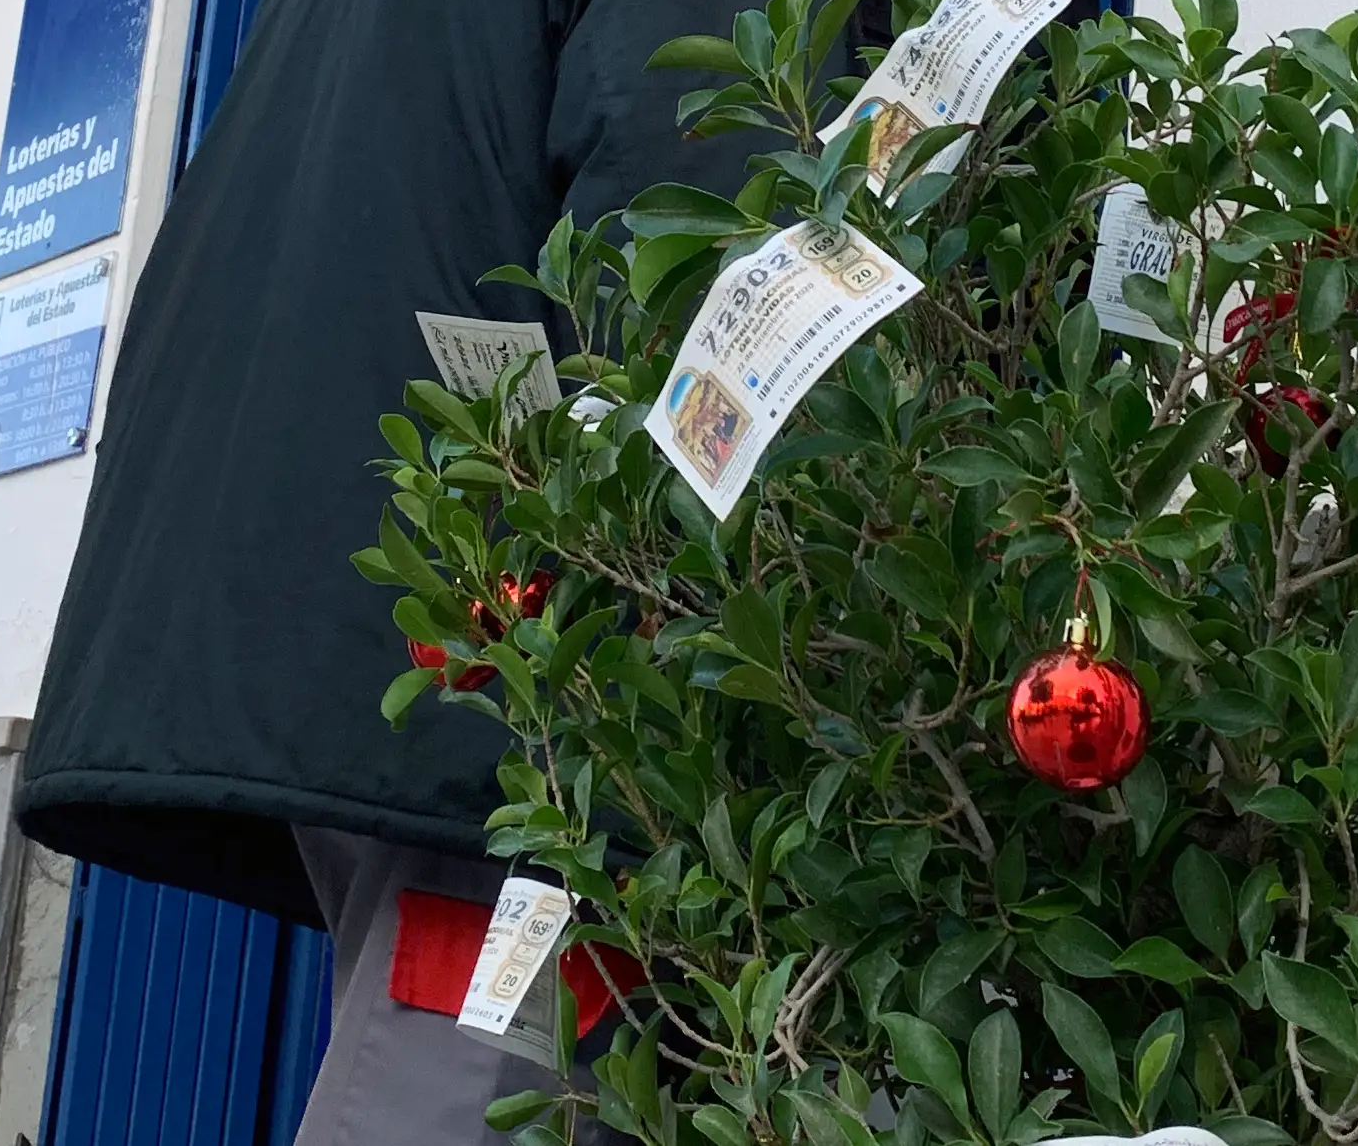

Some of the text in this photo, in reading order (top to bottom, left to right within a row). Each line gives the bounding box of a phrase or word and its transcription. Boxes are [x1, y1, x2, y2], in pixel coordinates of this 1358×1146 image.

[6, 115, 97, 175] Loterías y
[0, 137, 119, 219] Apuestas del
[10, 272, 101, 313] Loterías y Apuestas
[851, 268, 872, 285] 20
[27, 300, 76, 328] del Estado
[701, 252, 792, 354] 72902
[753, 309, 784, 351] diciembre
[503, 973, 518, 987] 20
